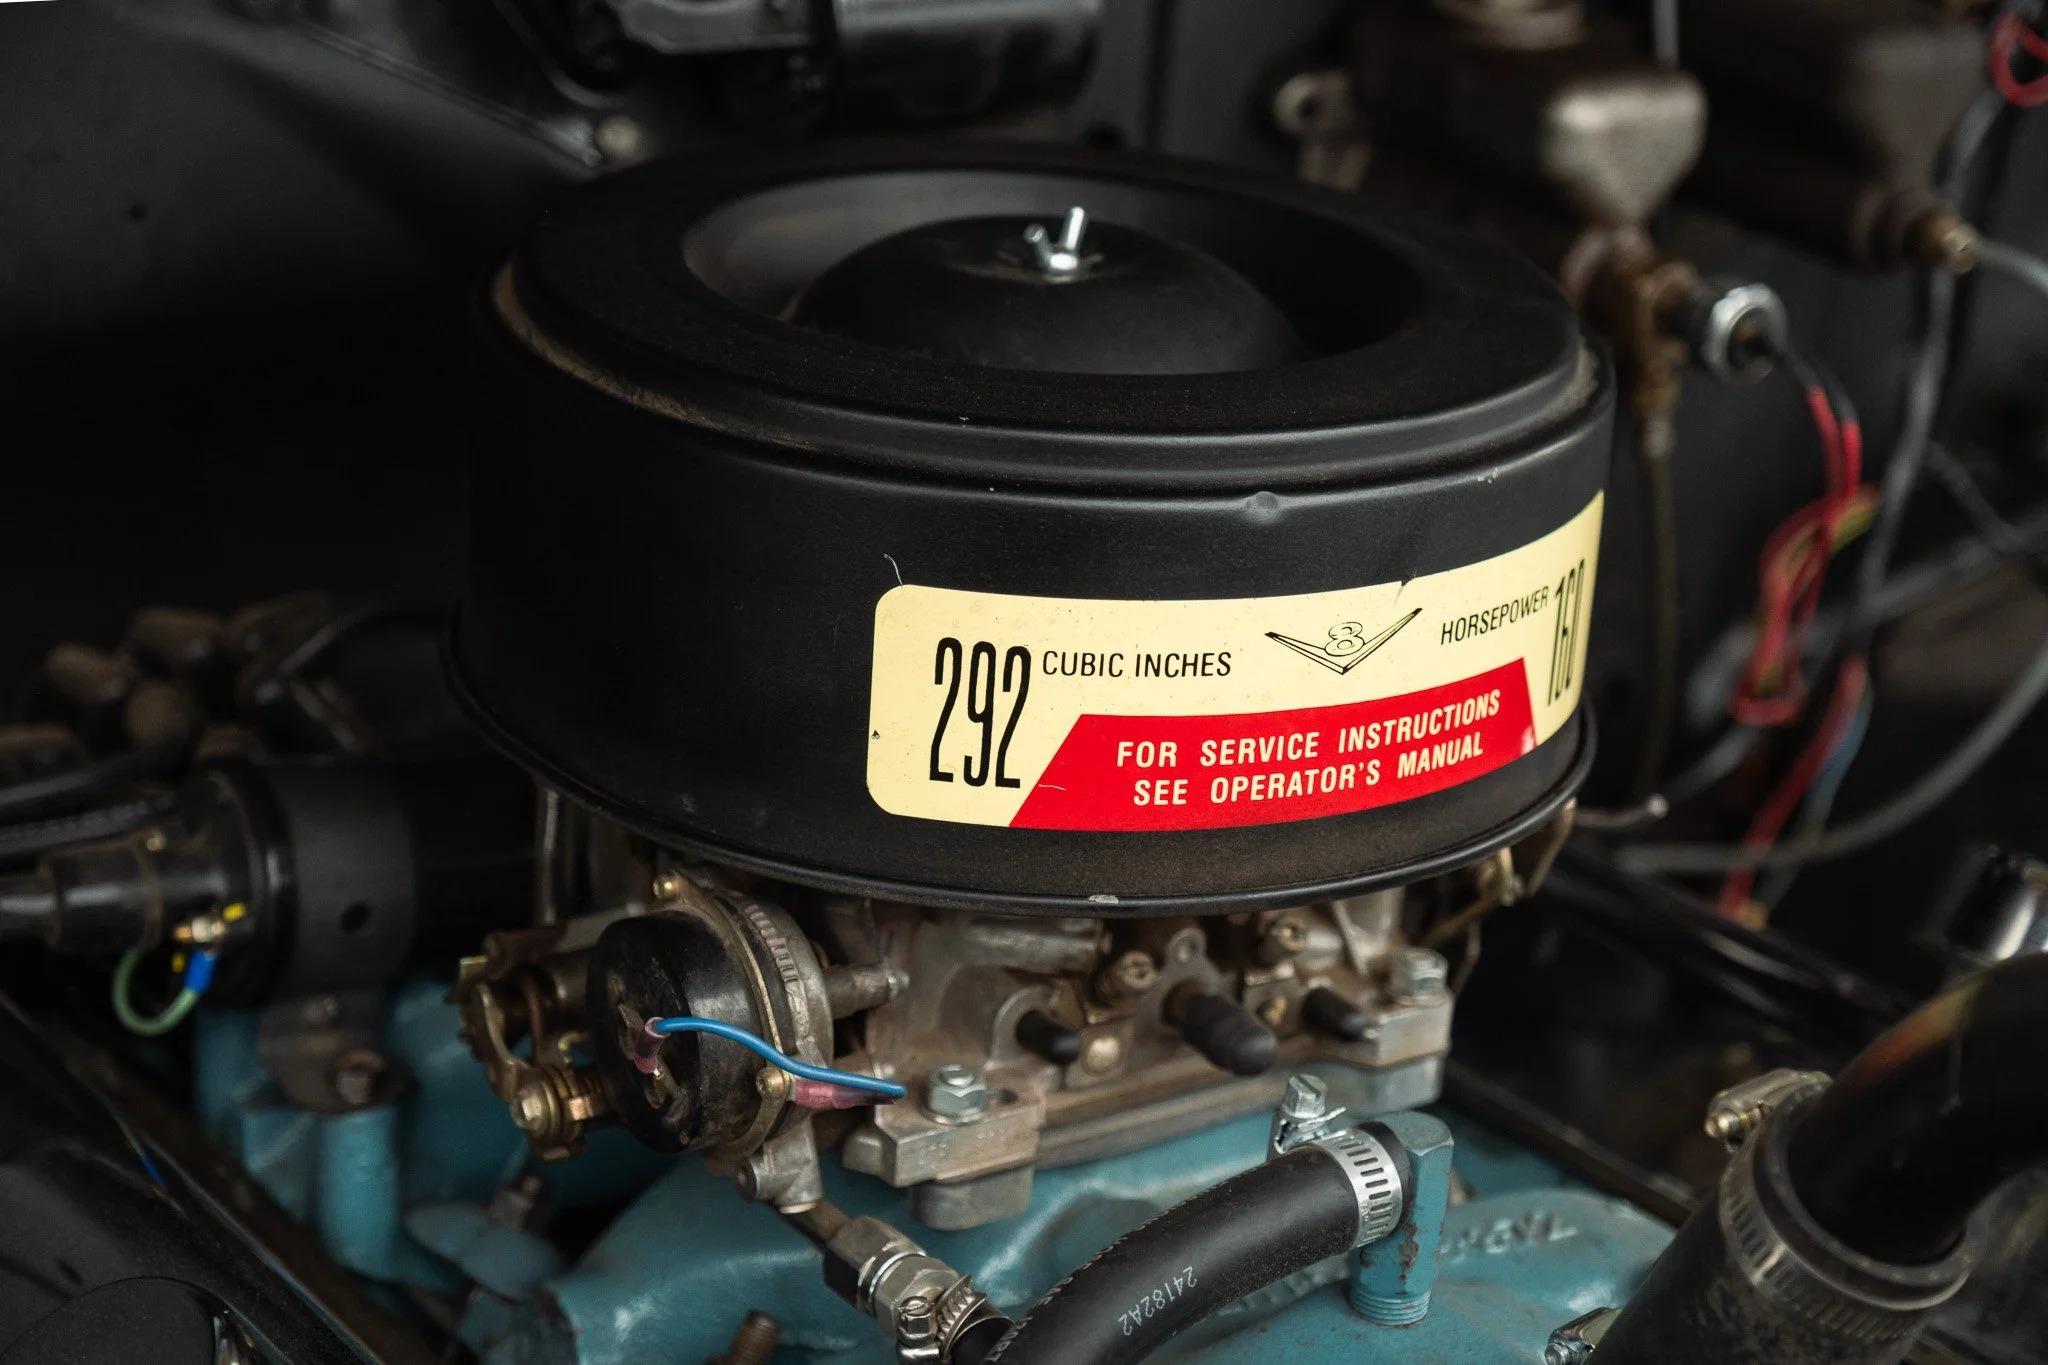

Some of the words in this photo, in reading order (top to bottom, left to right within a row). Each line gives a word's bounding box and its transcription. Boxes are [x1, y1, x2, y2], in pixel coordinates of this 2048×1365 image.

[1440, 586, 1549, 645] HORSEPOWER
[929, 637, 1031, 788] 292
[1042, 650, 1124, 677] CUBIC
[1135, 652, 1232, 677] INCHES
[1116, 741, 1178, 768] FOR
[1199, 732, 1320, 766] SERVICE
[1338, 689, 1501, 754] INSTRUCTIONS
[1133, 779, 1189, 806] SEE
[1210, 760, 1381, 804] OPERATOR'S
[1397, 733, 1483, 779] MANUAL
[1117, 1266, 1197, 1335] 24182A2
